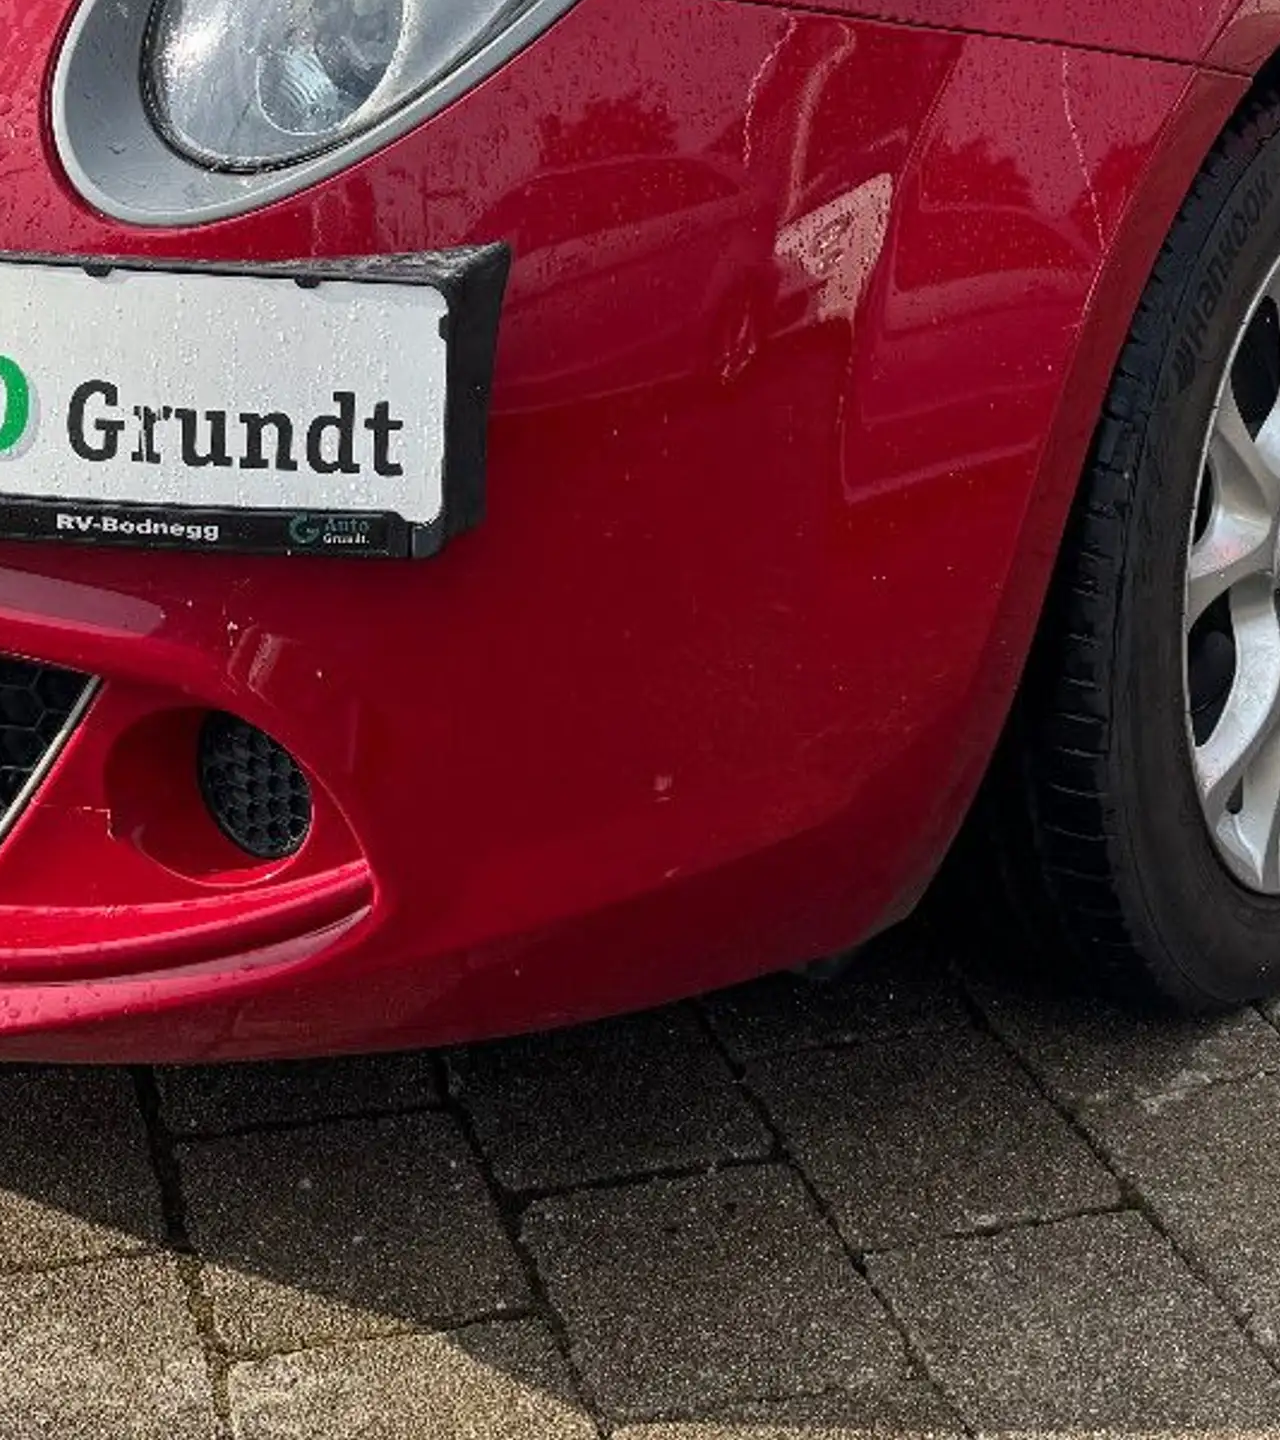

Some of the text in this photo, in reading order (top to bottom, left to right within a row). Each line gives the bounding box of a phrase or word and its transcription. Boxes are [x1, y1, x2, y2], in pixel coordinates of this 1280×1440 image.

[67, 379, 404, 477] Grundt
[56, 513, 219, 541] RV-Bodnegg
[324, 516, 370, 533] Auto
